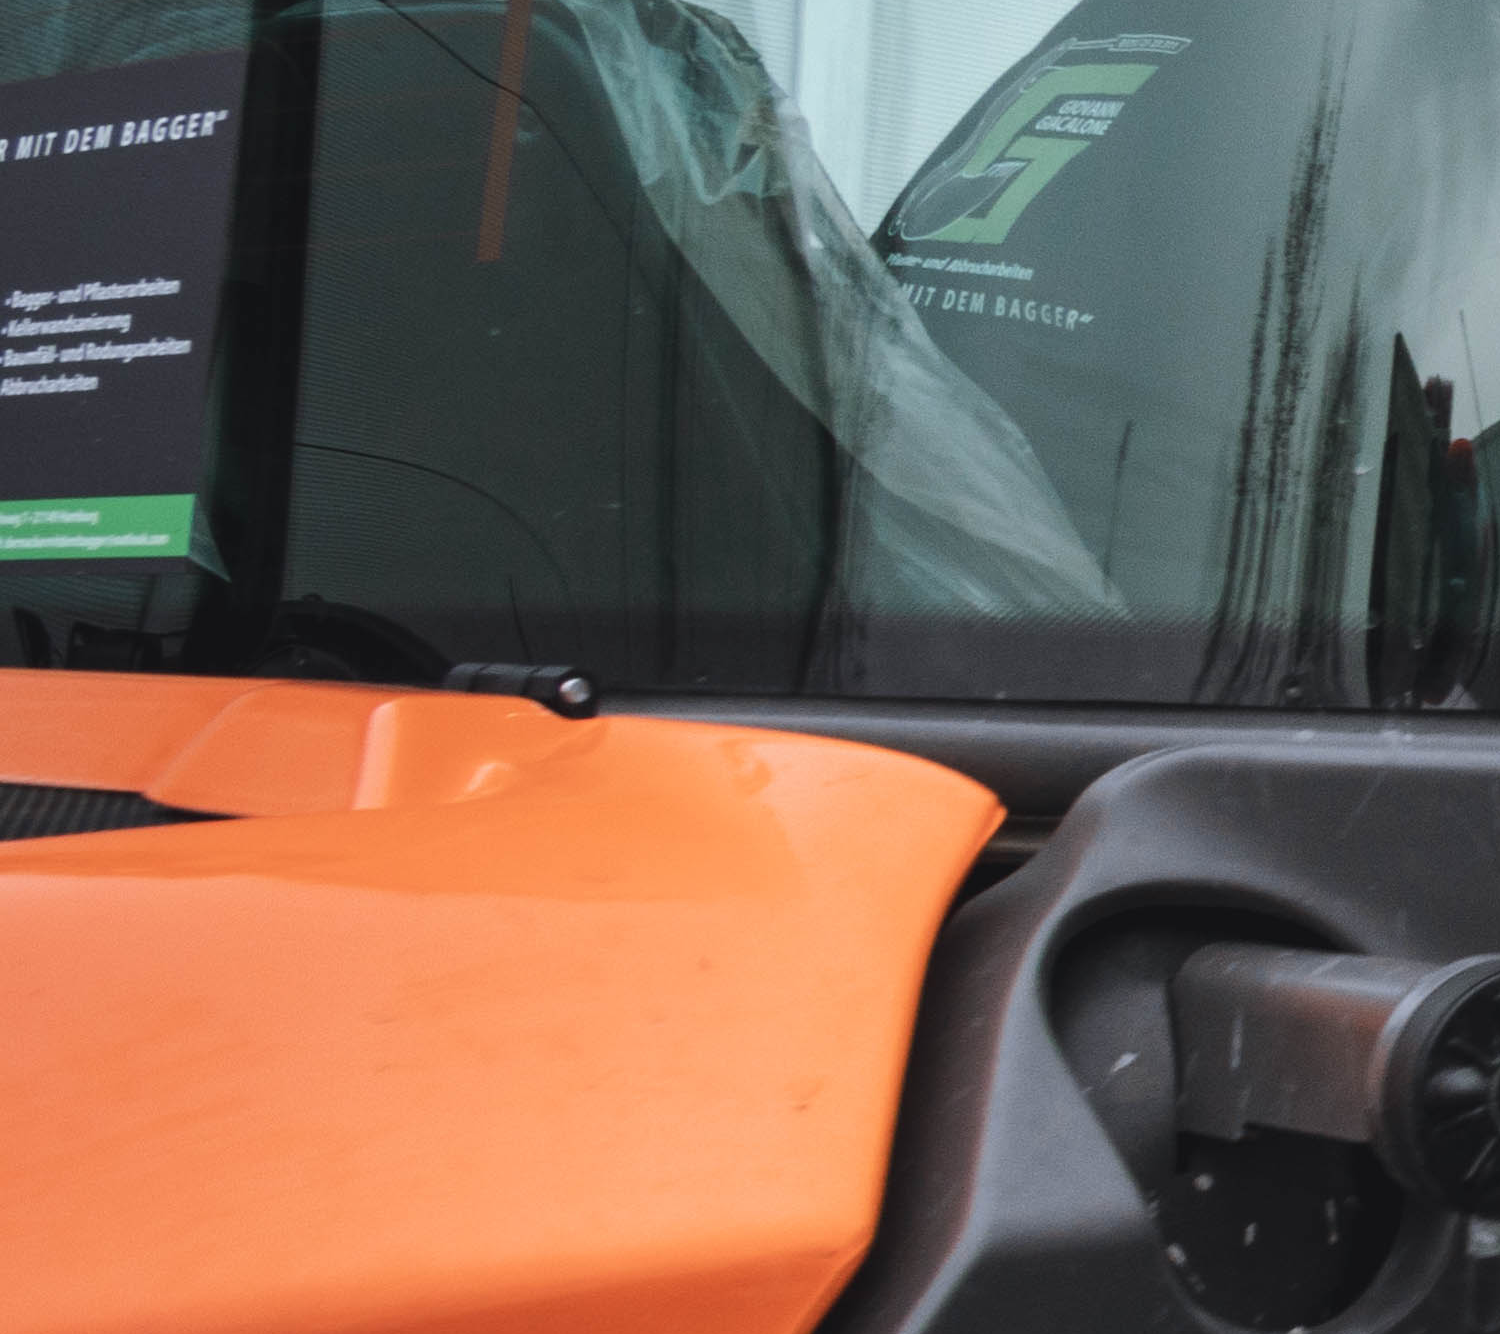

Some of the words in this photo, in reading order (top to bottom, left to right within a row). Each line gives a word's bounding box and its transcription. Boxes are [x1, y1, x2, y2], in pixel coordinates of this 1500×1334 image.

[15, 132, 58, 160] MIT
[62, 124, 113, 154] DEM
[941, 289, 985, 314] DEM
